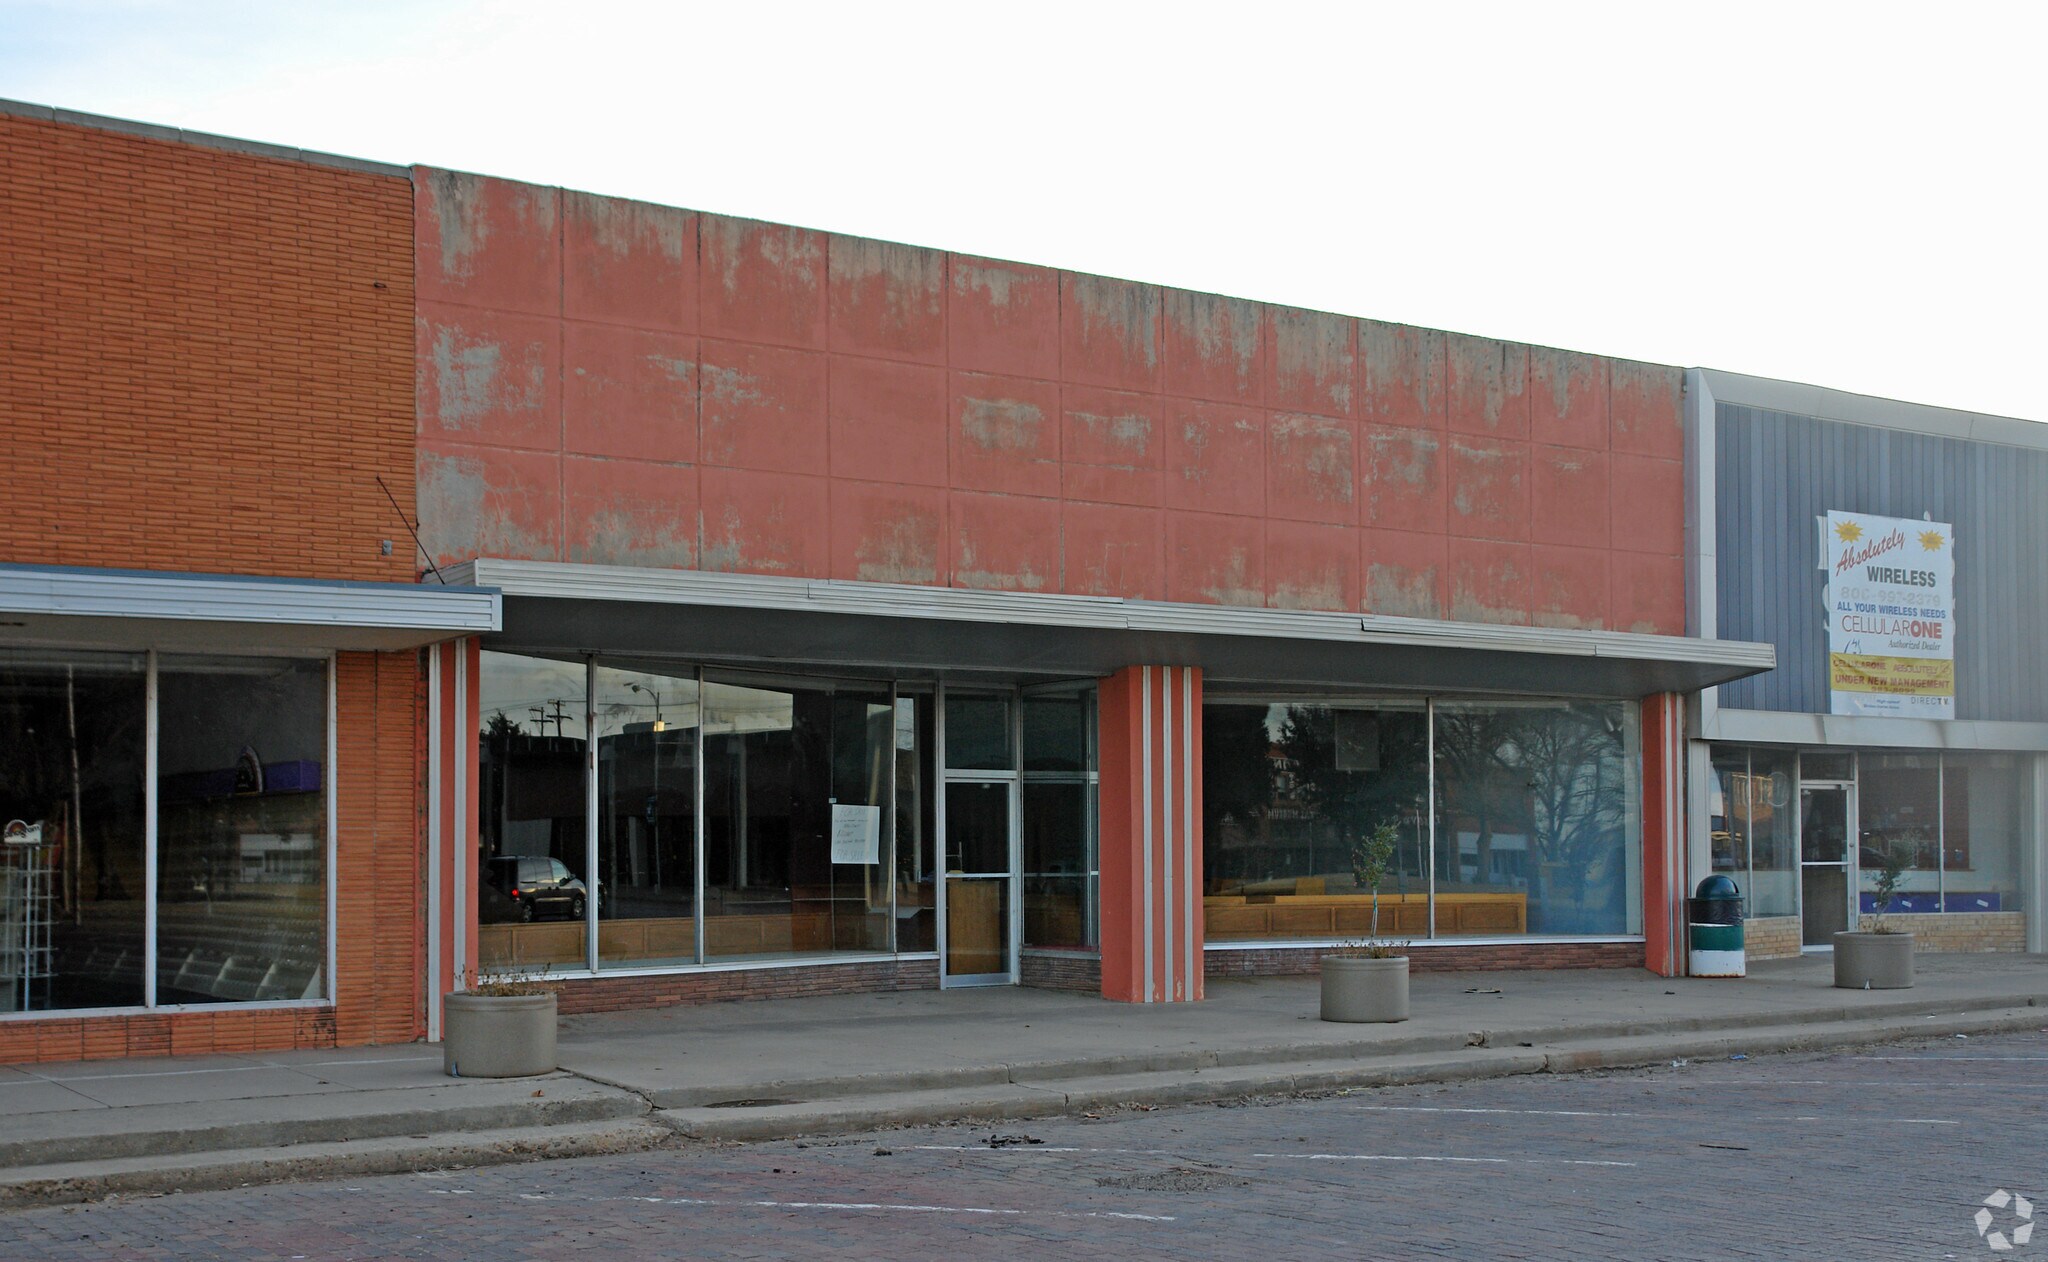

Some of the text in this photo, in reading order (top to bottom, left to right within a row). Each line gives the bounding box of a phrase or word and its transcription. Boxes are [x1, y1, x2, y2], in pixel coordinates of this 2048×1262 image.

[1836, 527, 1905, 576] Absolutely
[1867, 565, 1936, 588] WIRELESS
[1837, 601, 1946, 619] ALL YOUR WIRELESS NEEDS
[1842, 615, 1942, 639] CELLULARONE
[1921, 641, 1941, 651] Dealer
[1835, 674, 1950, 689] UNDER NEW MANAGEMENT
